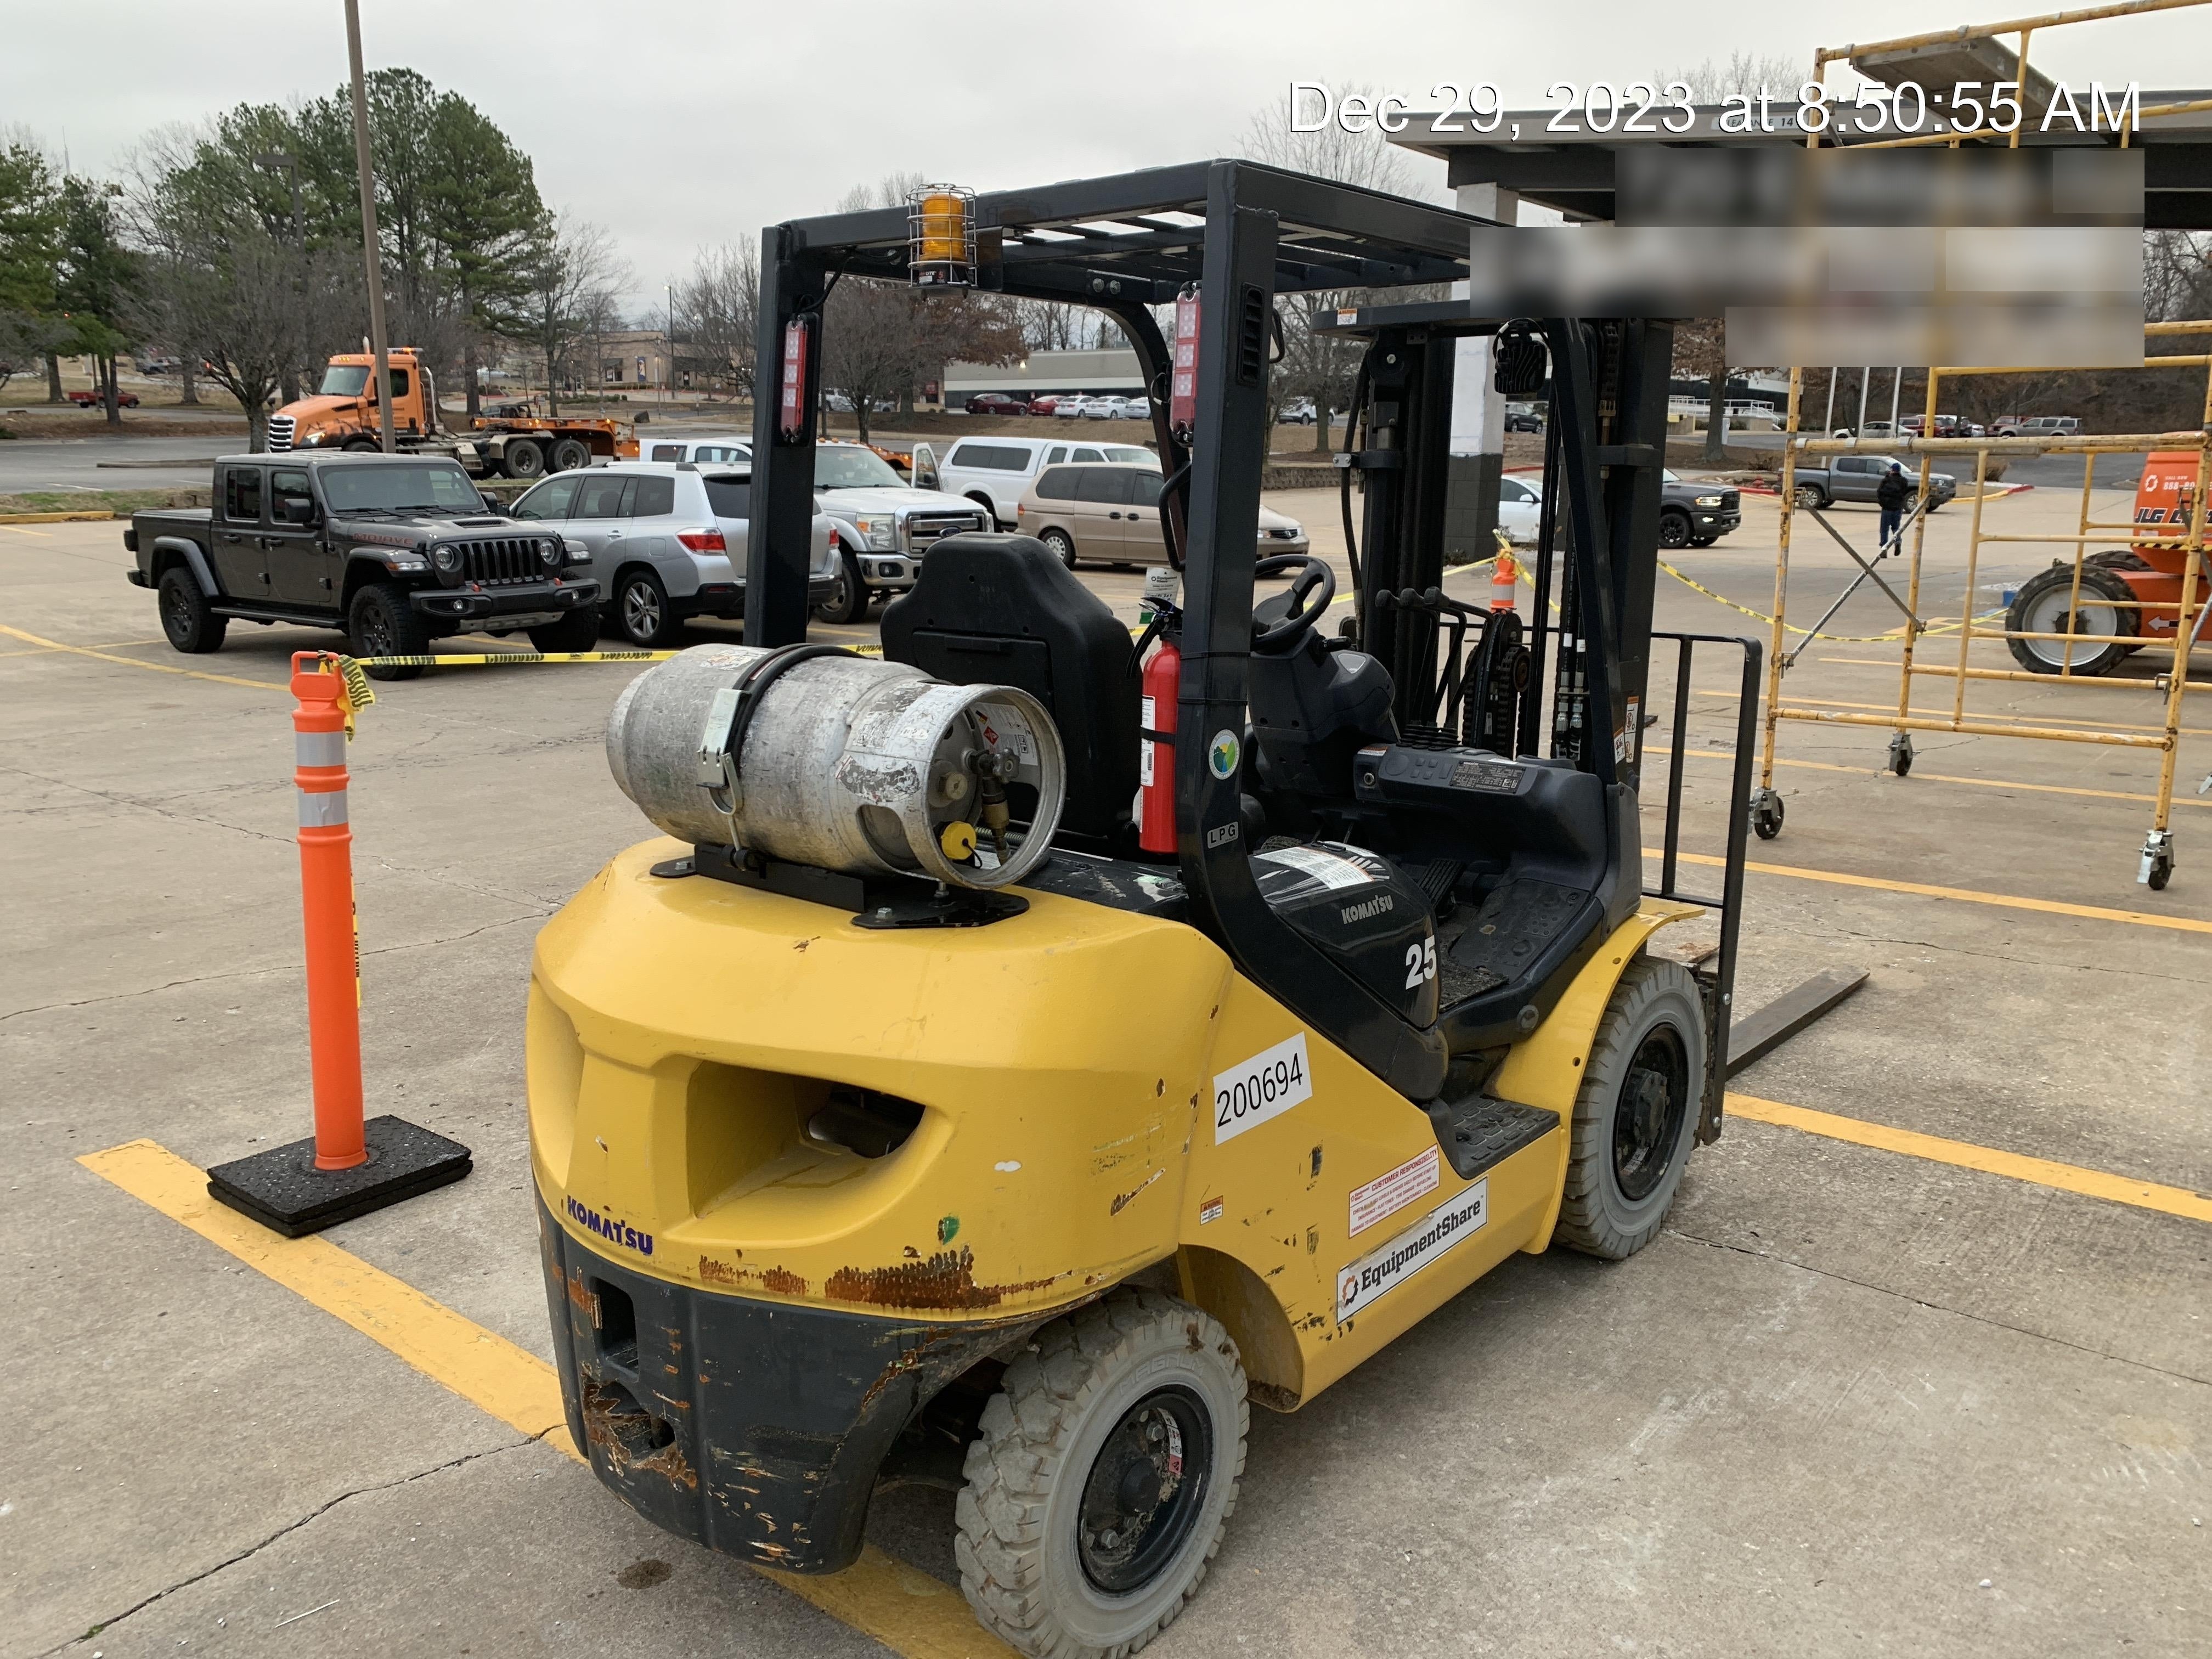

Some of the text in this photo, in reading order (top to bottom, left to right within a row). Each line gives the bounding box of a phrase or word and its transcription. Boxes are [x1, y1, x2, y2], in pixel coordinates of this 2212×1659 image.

[2135, 507, 2168, 523] JLG
[352, 533, 413, 545] MOJAVE
[1211, 825, 1235, 843] LPG
[1341, 895, 1393, 924] KOMATSU
[1406, 935, 1437, 990] 25
[1217, 1053, 1302, 1127] 200694
[1372, 1148, 1436, 1191] CUSTOMER RESPONSIBILITY
[567, 1195, 653, 1255] KOMATSU
[1361, 1200, 1480, 1291] EquipmentShare
